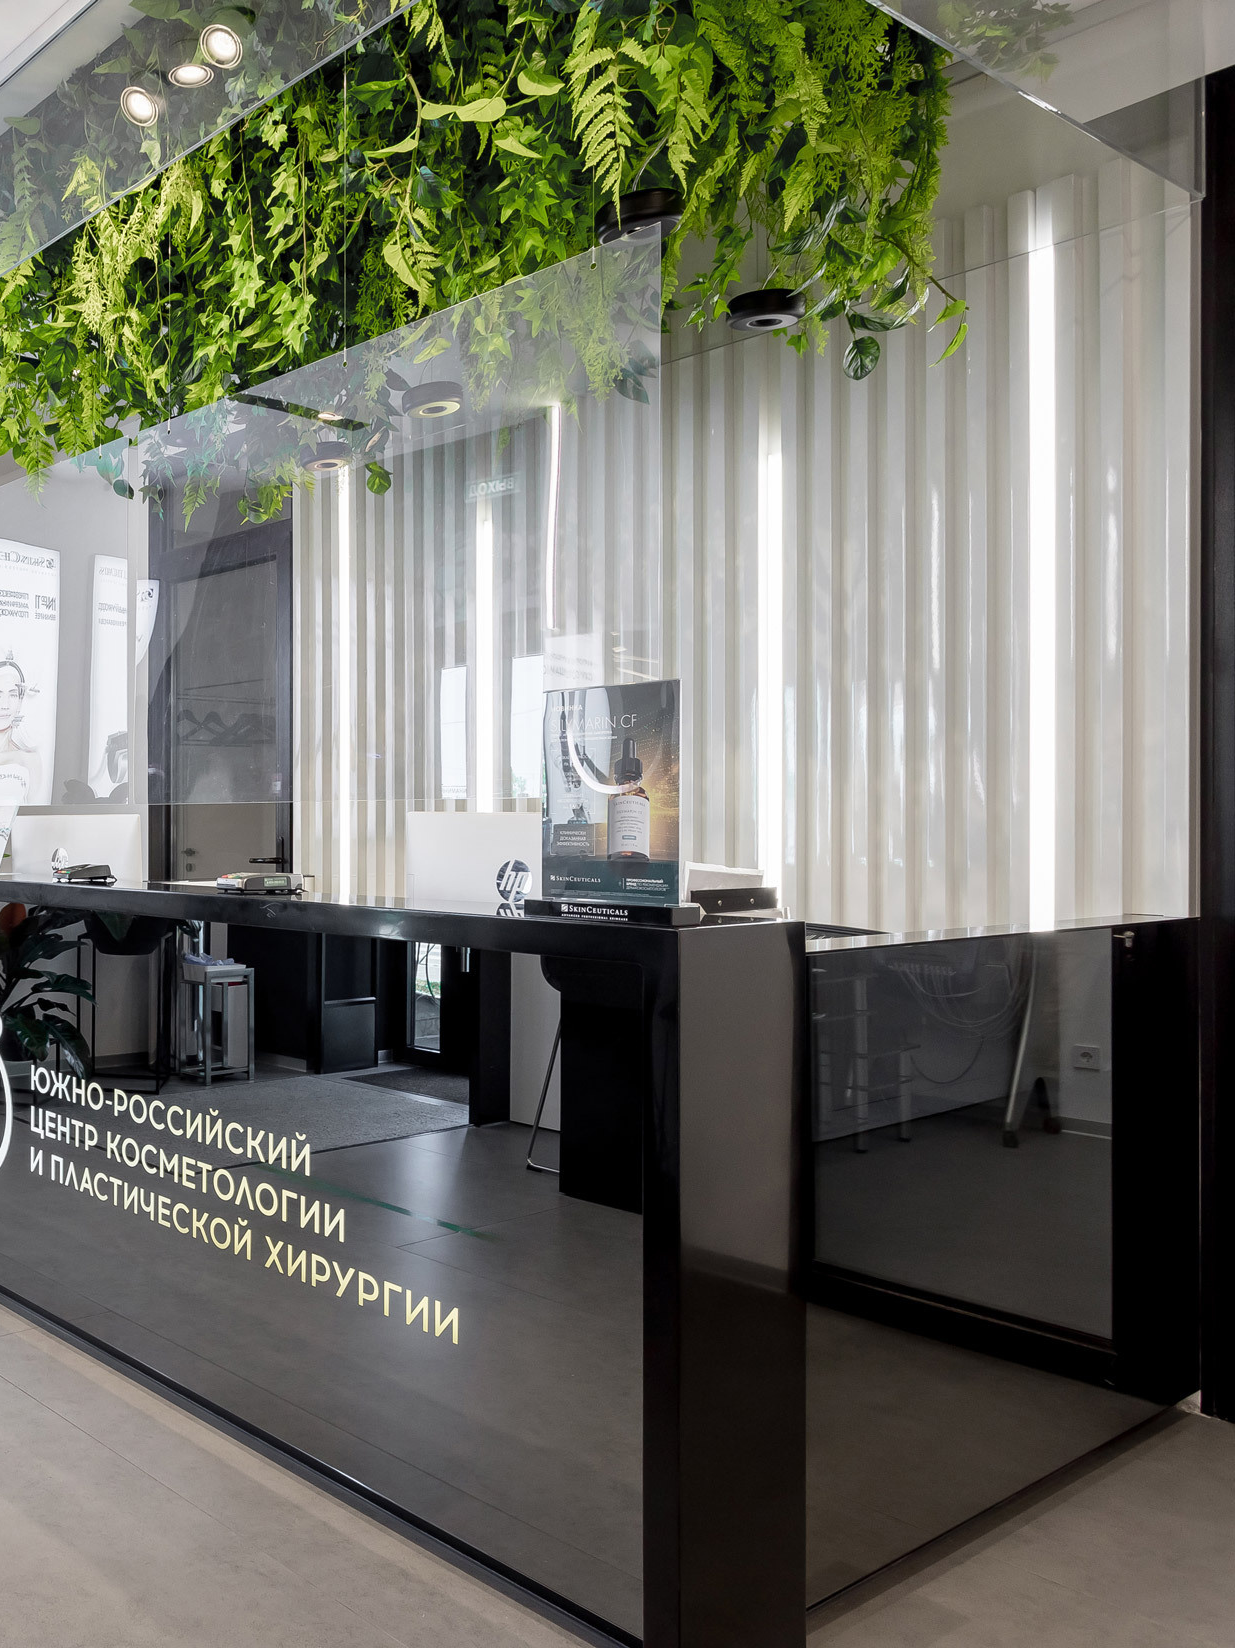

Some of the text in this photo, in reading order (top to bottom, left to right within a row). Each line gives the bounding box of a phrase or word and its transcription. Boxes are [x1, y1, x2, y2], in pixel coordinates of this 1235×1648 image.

[551, 713, 638, 732] SILYMARIN CF
[497, 859, 531, 902] hp
[556, 875, 601, 883] SKINCEUTICALS
[568, 904, 629, 916] SKINCEUTICALS
[30, 1064, 312, 1177] ЮЖНО-РОССИЙСКИЙ
[30, 1105, 346, 1243] ЦЕНТР КОСМЕТОЛОГИИ
[30, 1146, 460, 1346] И ПЛАСТИЧЕСКОЙ ХИРУРГИИ
